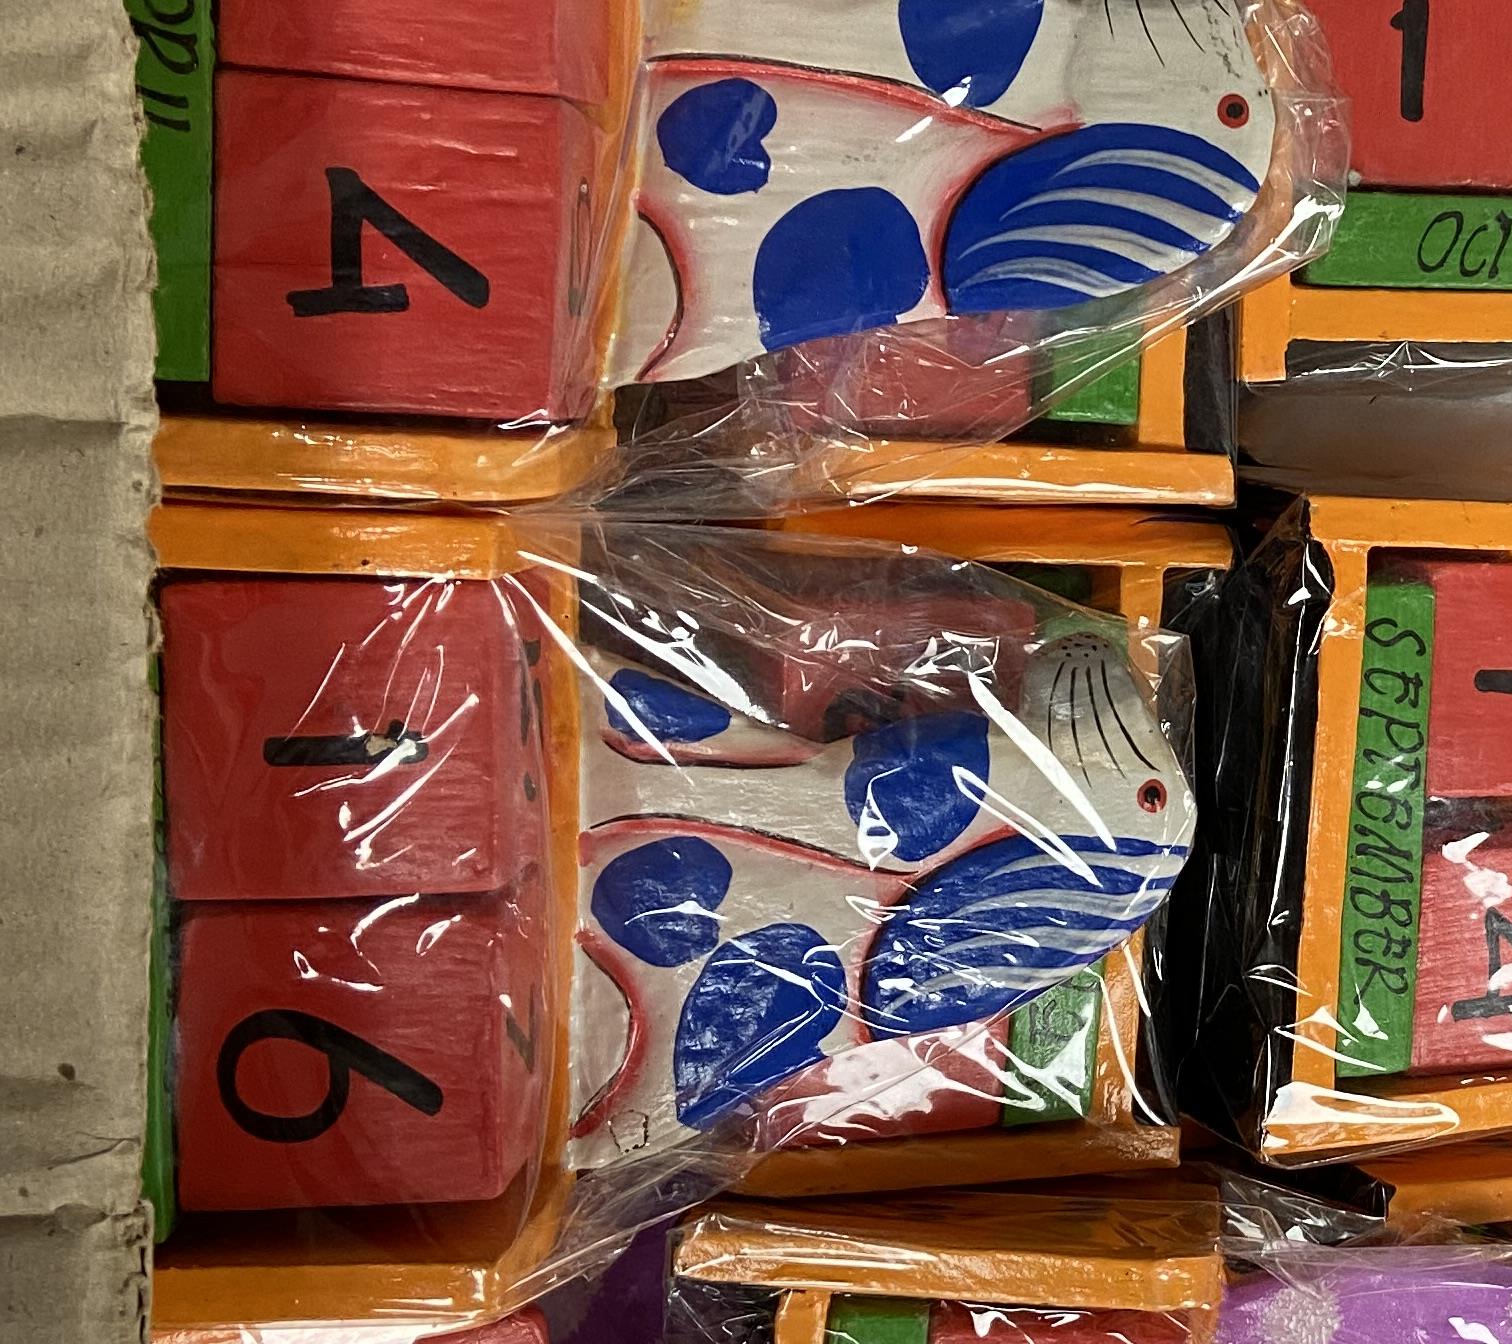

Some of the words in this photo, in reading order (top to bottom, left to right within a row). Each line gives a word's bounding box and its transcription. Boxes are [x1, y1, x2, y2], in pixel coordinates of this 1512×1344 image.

[285, 167, 490, 316] 4
[262, 719, 429, 766] 1
[1351, 616, 1426, 998] SEPTEMBER
[216, 1008, 445, 1143] 6
